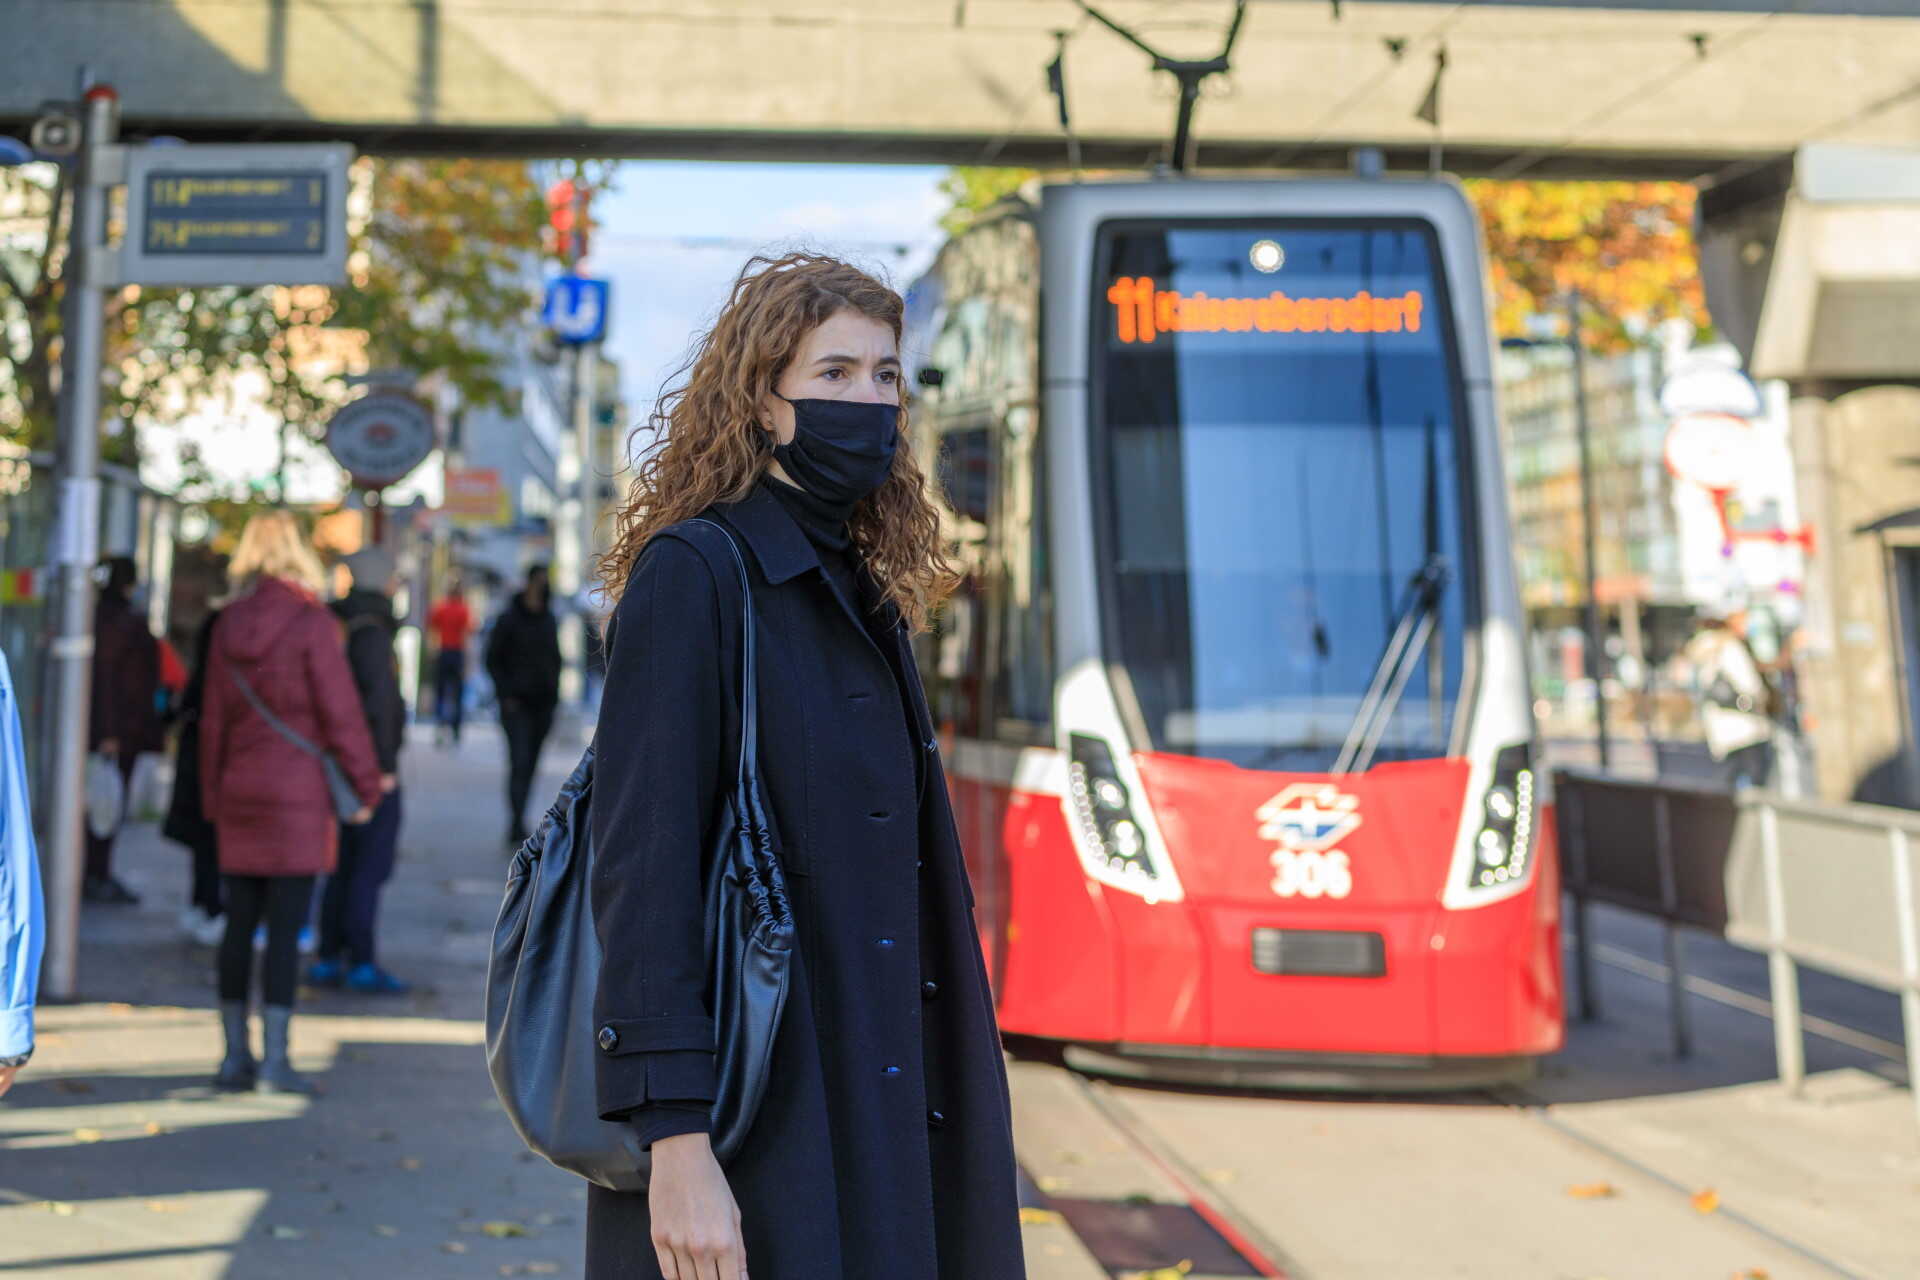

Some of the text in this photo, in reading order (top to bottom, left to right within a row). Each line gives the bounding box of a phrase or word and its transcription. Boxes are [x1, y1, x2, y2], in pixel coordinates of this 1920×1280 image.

[553, 281, 600, 334] U
[1107, 276, 1156, 343] 11
[1269, 849, 1353, 899] 306
